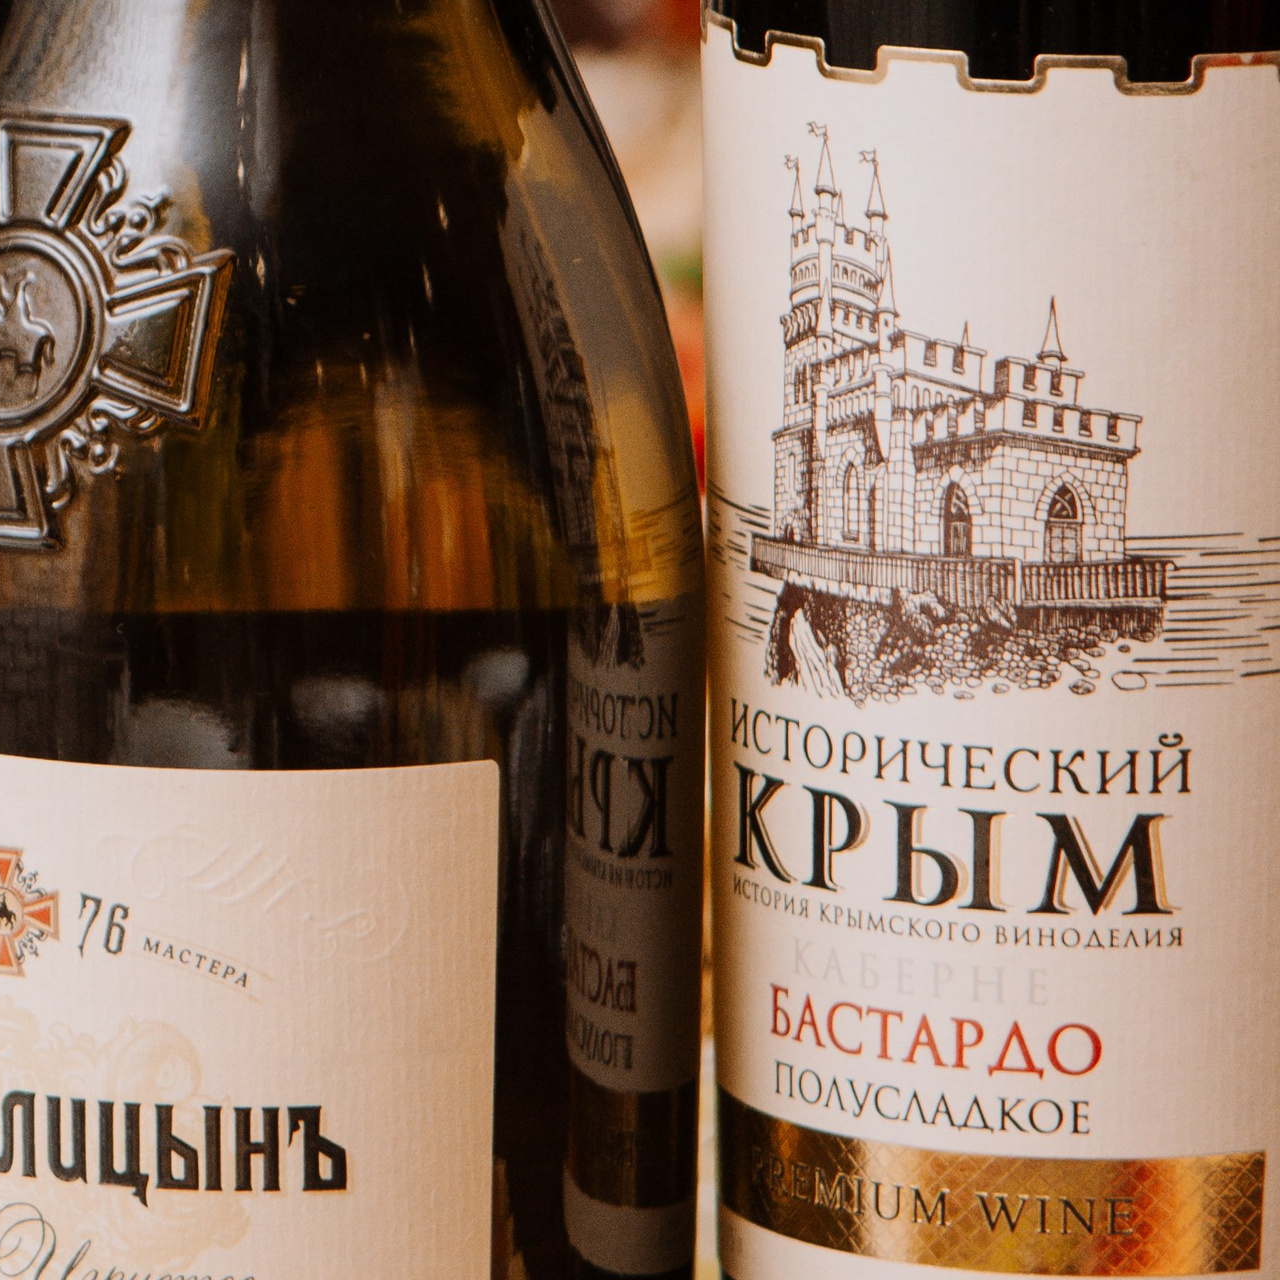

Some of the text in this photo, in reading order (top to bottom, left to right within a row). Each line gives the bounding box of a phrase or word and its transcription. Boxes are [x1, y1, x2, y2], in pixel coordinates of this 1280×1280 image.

[730, 698, 1192, 796] ИСТОРИЧЕСКИЙ
[732, 760, 1181, 917] КРЫМ
[79, 891, 130, 959] 76
[142, 936, 250, 989] МАСТЕРА
[732, 873, 1184, 951] ИСТОРИЯ КРЫМСКОГО ВИНОДЕЛИЯ
[792, 936, 1049, 1007] КАБЕРНЕ
[768, 982, 1103, 1080] БАСТАРДО
[774, 1059, 1091, 1136] ПОЛУСЛАДКОЕ
[750, 1145, 1135, 1237] PREMIUM WINE
